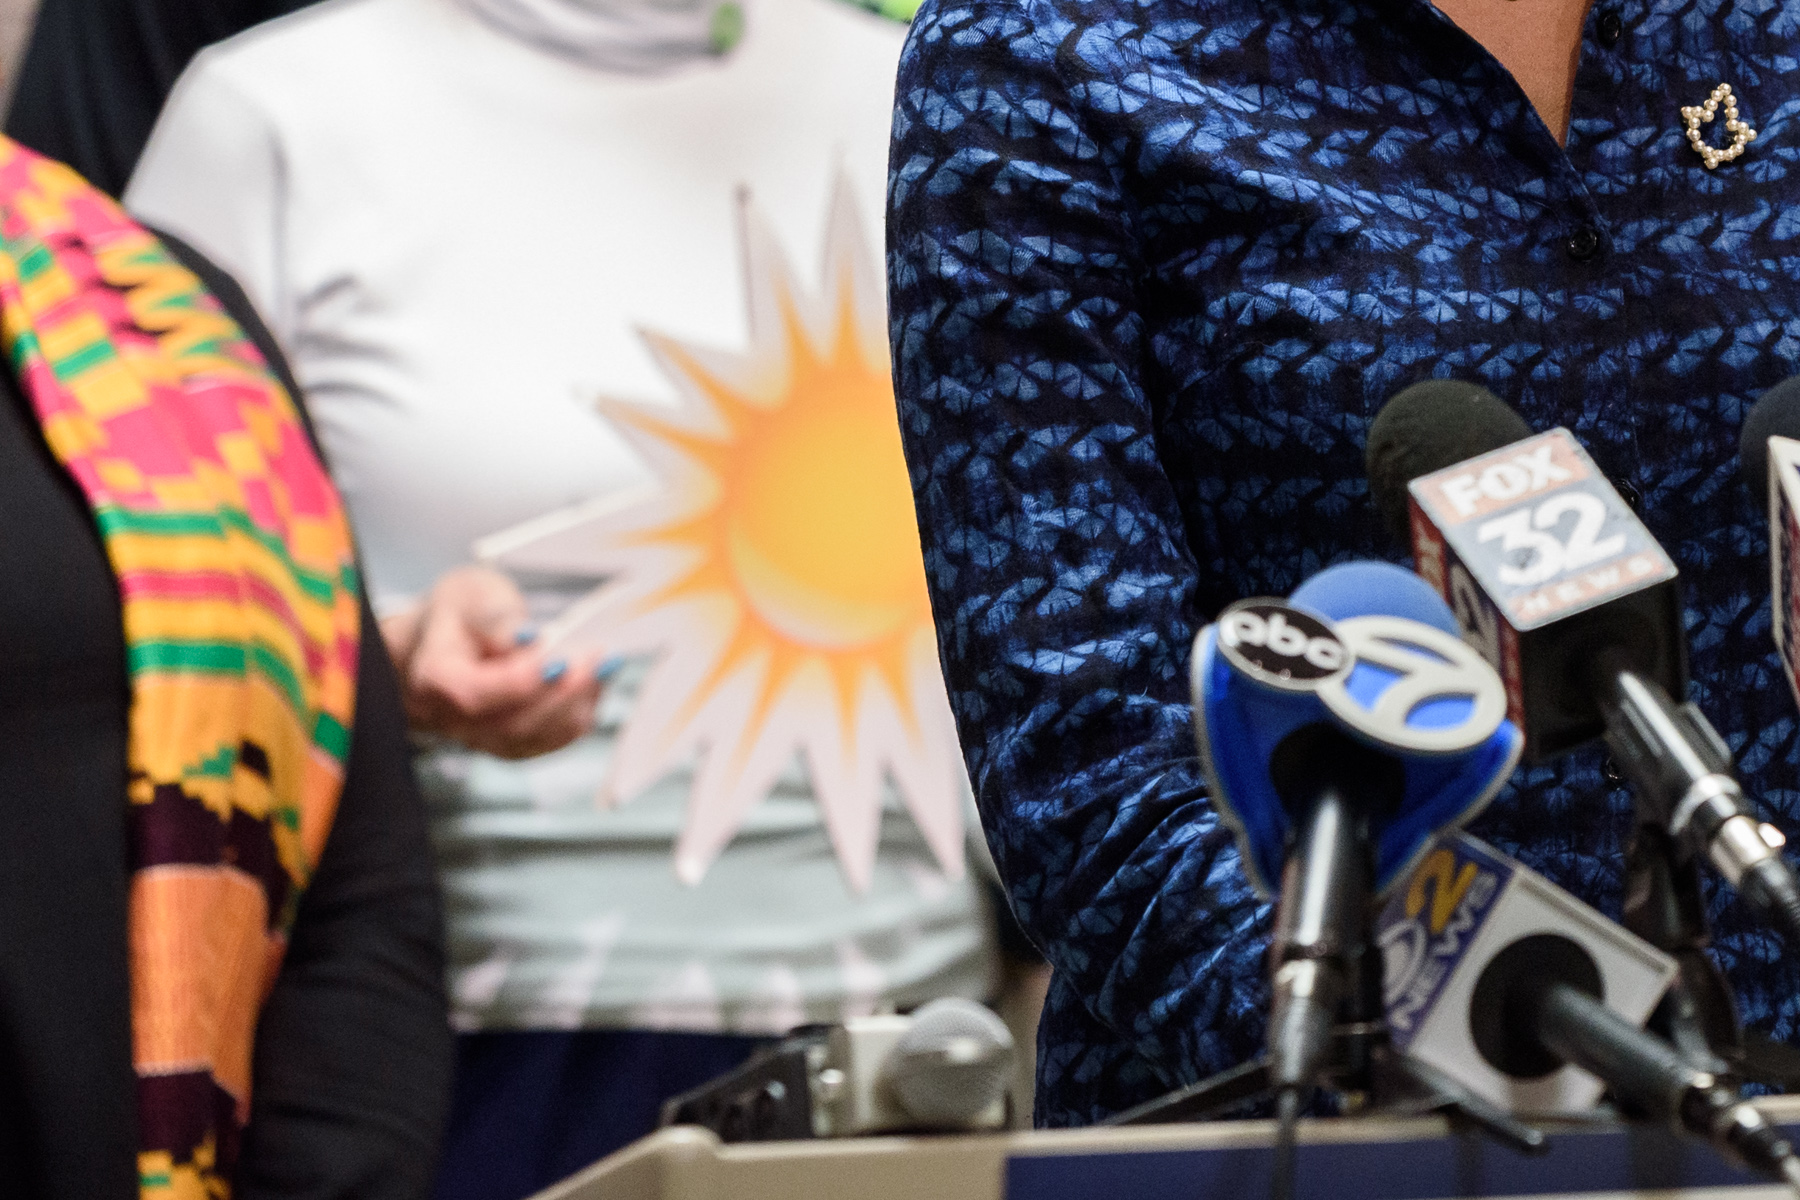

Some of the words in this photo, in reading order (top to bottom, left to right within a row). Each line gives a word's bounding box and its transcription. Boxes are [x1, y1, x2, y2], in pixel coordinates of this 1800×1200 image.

[1440, 444, 1572, 517] FOX
[1477, 491, 1627, 586] 32
[1219, 610, 1344, 671] abc
[1405, 849, 1479, 934] 2
